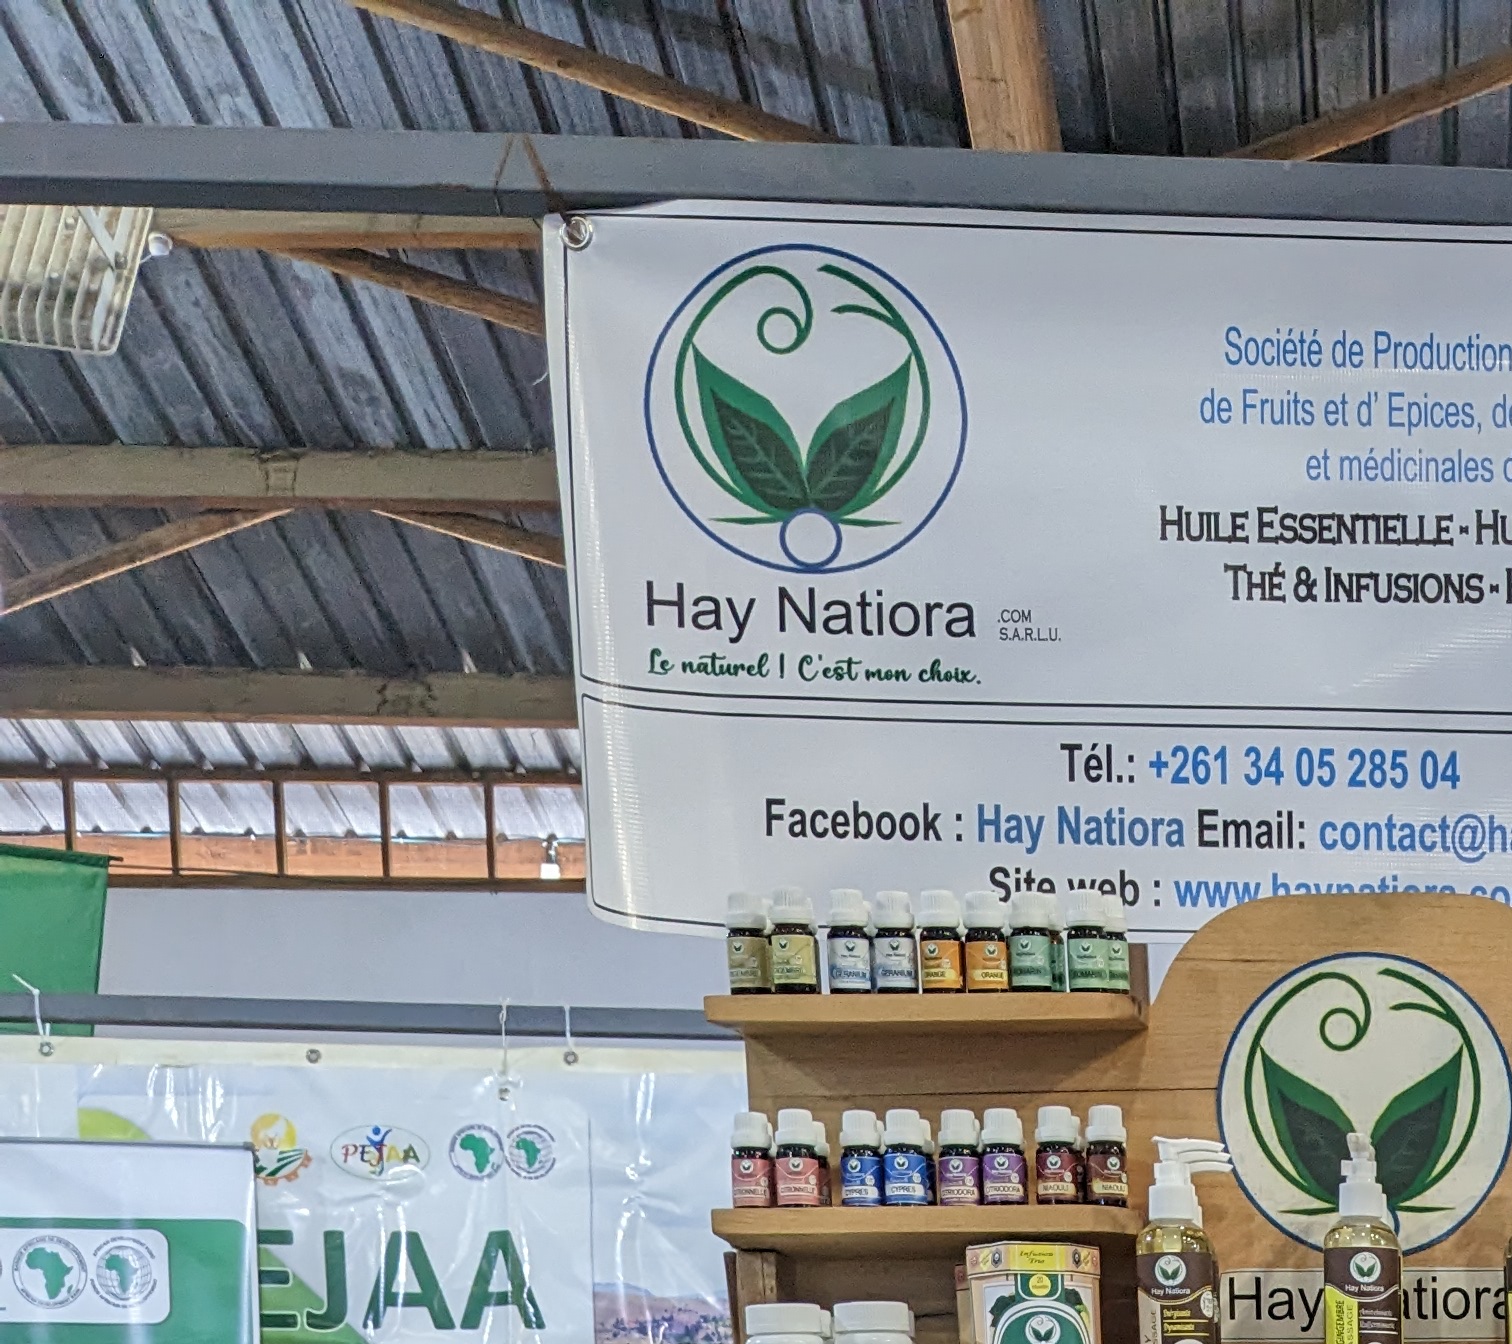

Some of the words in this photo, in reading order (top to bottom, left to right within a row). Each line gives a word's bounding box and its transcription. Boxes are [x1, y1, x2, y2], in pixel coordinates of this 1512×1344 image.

[1225, 327, 1323, 370] Société
[1332, 330, 1364, 371] de
[1374, 331, 1512, 373] Production
[1200, 388, 1233, 426] de
[1242, 389, 1315, 429] Fruits
[1323, 393, 1351, 429] et
[1388, 393, 1483, 436] Epices,
[1306, 450, 1329, 481] et
[1339, 449, 1495, 484] médicinales
[1293, 568, 1317, 603] &
[646, 580, 755, 644] Hay
[779, 587, 977, 638] Natiora
[648, 648, 674, 677] Le
[682, 652, 769, 680] naturel
[778, 653, 785, 679] !
[799, 653, 858, 683] C'est
[865, 663, 911, 683] mon
[918, 657, 982, 686] choix.
[1148, 745, 1229, 786] +261
[1245, 745, 1284, 788] 34
[1295, 747, 1336, 788] 05
[1347, 747, 1410, 790] 285
[1420, 749, 1461, 791] 04
[764, 798, 942, 843] Facebook
[977, 803, 1044, 855] Hay
[1056, 805, 1185, 849] Natiora
[1198, 811, 1306, 852] Email:
[341, 1141, 421, 1167] PEJAA
[1228, 1276, 1324, 1333] Hay
